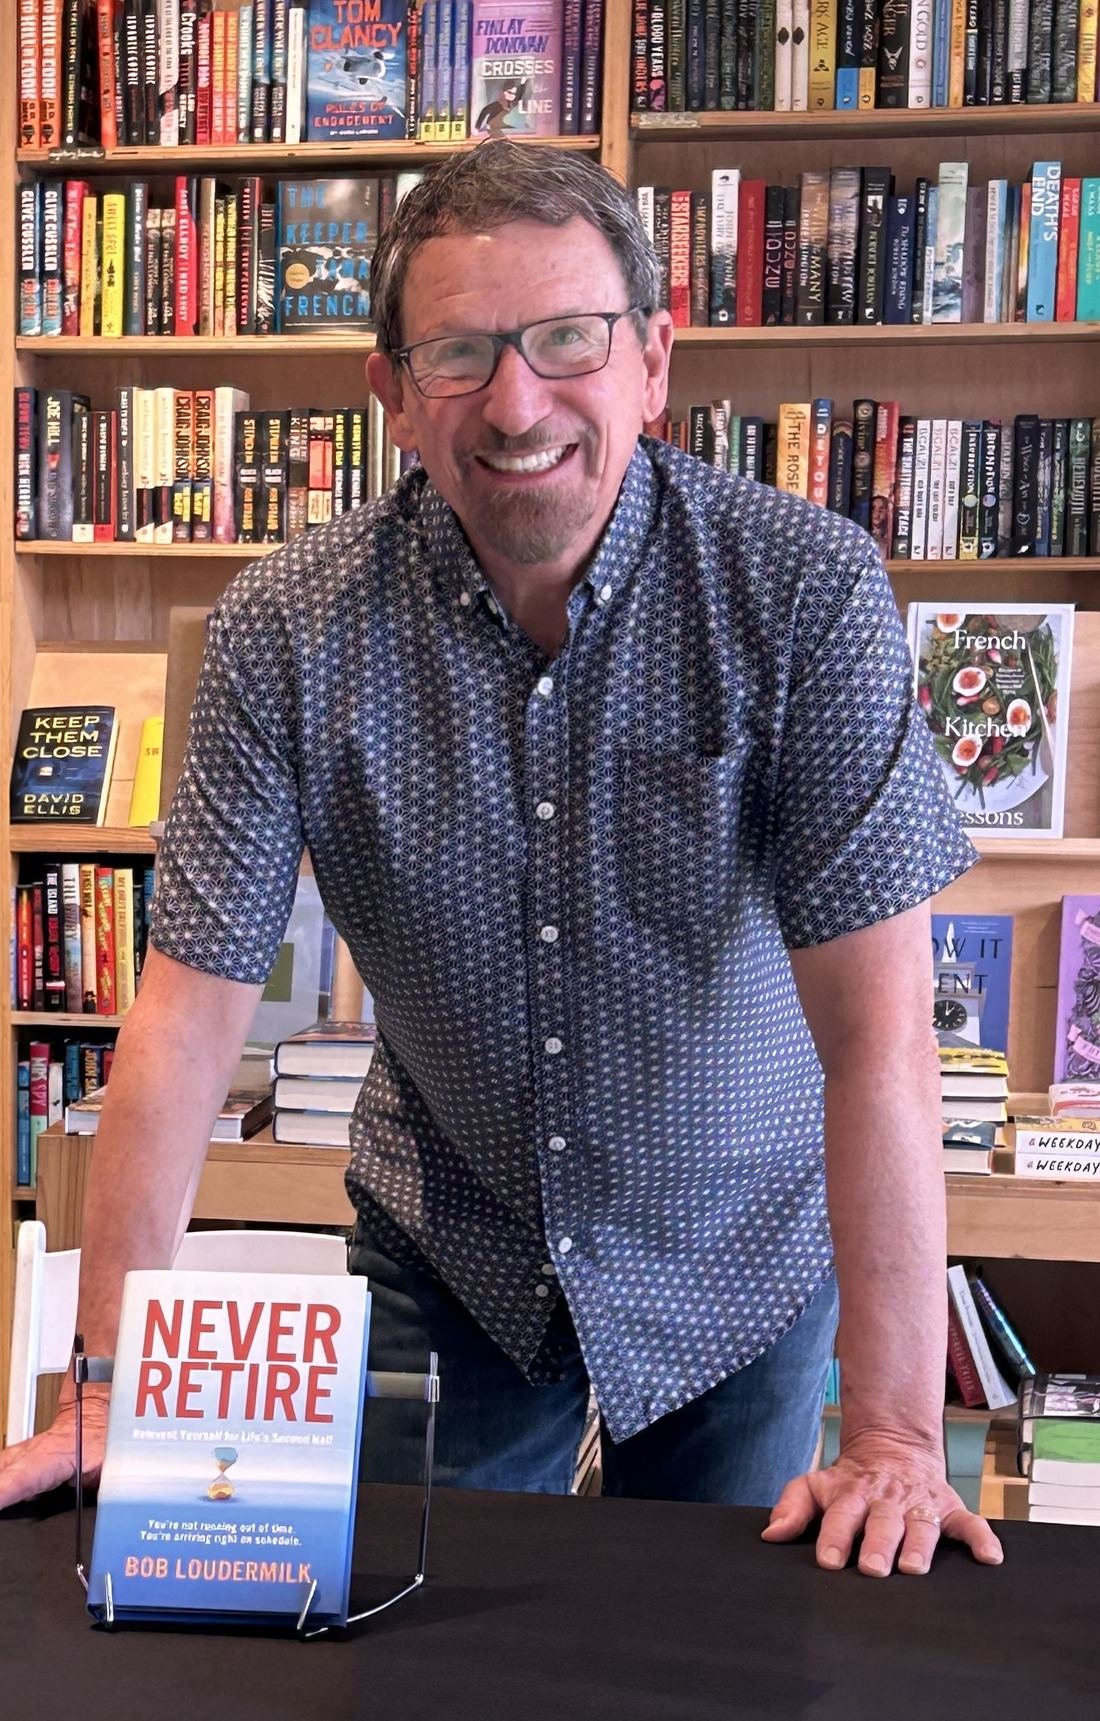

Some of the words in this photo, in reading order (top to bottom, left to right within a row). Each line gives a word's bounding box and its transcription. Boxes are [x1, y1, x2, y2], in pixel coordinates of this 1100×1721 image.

[335, 0, 381, 24] TOM
[21, 15, 37, 46] KILL
[42, 15, 57, 46] KILL
[310, 22, 403, 51] CLANCY
[475, 18, 526, 36] FINLAY
[485, 35, 551, 55] DONOVAN
[482, 60, 555, 76] CROSSES
[650, 45, 665, 78] YEARS
[518, 100, 553, 114] LINE
[21, 190, 35, 222] CLIVE
[45, 191, 58, 222] CLIVE
[1031, 177, 1046, 217] END
[1043, 166, 1061, 242] DEATH'S
[286, 221, 368, 245] KEEPER
[673, 202, 690, 285] STARSEEKERS
[809, 256, 822, 303] MANY
[284, 294, 370, 317] FRENCH
[47, 396, 60, 419] JOE
[175, 396, 191, 429] CRAIG
[195, 396, 212, 429] CRAIG
[47, 420, 60, 446] HILL
[289, 416, 300, 453] KING
[787, 422, 802, 449] THE
[902, 437, 914, 452] THE
[174, 430, 191, 482] JOHNSON
[195, 430, 211, 482] JOHNSON
[786, 454, 801, 490] ROSE
[897, 509, 911, 535] PEACE
[953, 629, 1026, 650] French
[35, 715, 100, 730] KEEP
[944, 717, 1027, 738] Kitchen
[30, 730, 99, 744] THEM
[23, 746, 103, 758] CLOSE
[23, 804, 81, 815] ELLIS
[24, 793, 84, 804] DAVID
[957, 811, 1024, 826] essons
[47, 887, 58, 914] ISLAND
[980, 938, 1003, 959] IT
[938, 974, 988, 995] ENT
[1036, 1159, 1100, 1175] WEEKDAY
[142, 1299, 342, 1364] NEVER
[135, 1361, 338, 1423] RETIRE
[180, 1429, 223, 1441] Yourself
[224, 1431, 239, 1442] for
[241, 1431, 269, 1444] Life's
[272, 1432, 310, 1445] Second
[140, 1530, 171, 1541] You're
[174, 1531, 212, 1545] arriving
[214, 1532, 237, 1545] right
[240, 1534, 252, 1544] on
[255, 1535, 303, 1547] schedule.
[148, 1518, 179, 1531] You're
[181, 1520, 198, 1531] not
[239, 1522, 256, 1533] out
[259, 1522, 270, 1534] of
[124, 1555, 169, 1578] BOB
[174, 1558, 312, 1584] LOUDERMILK
